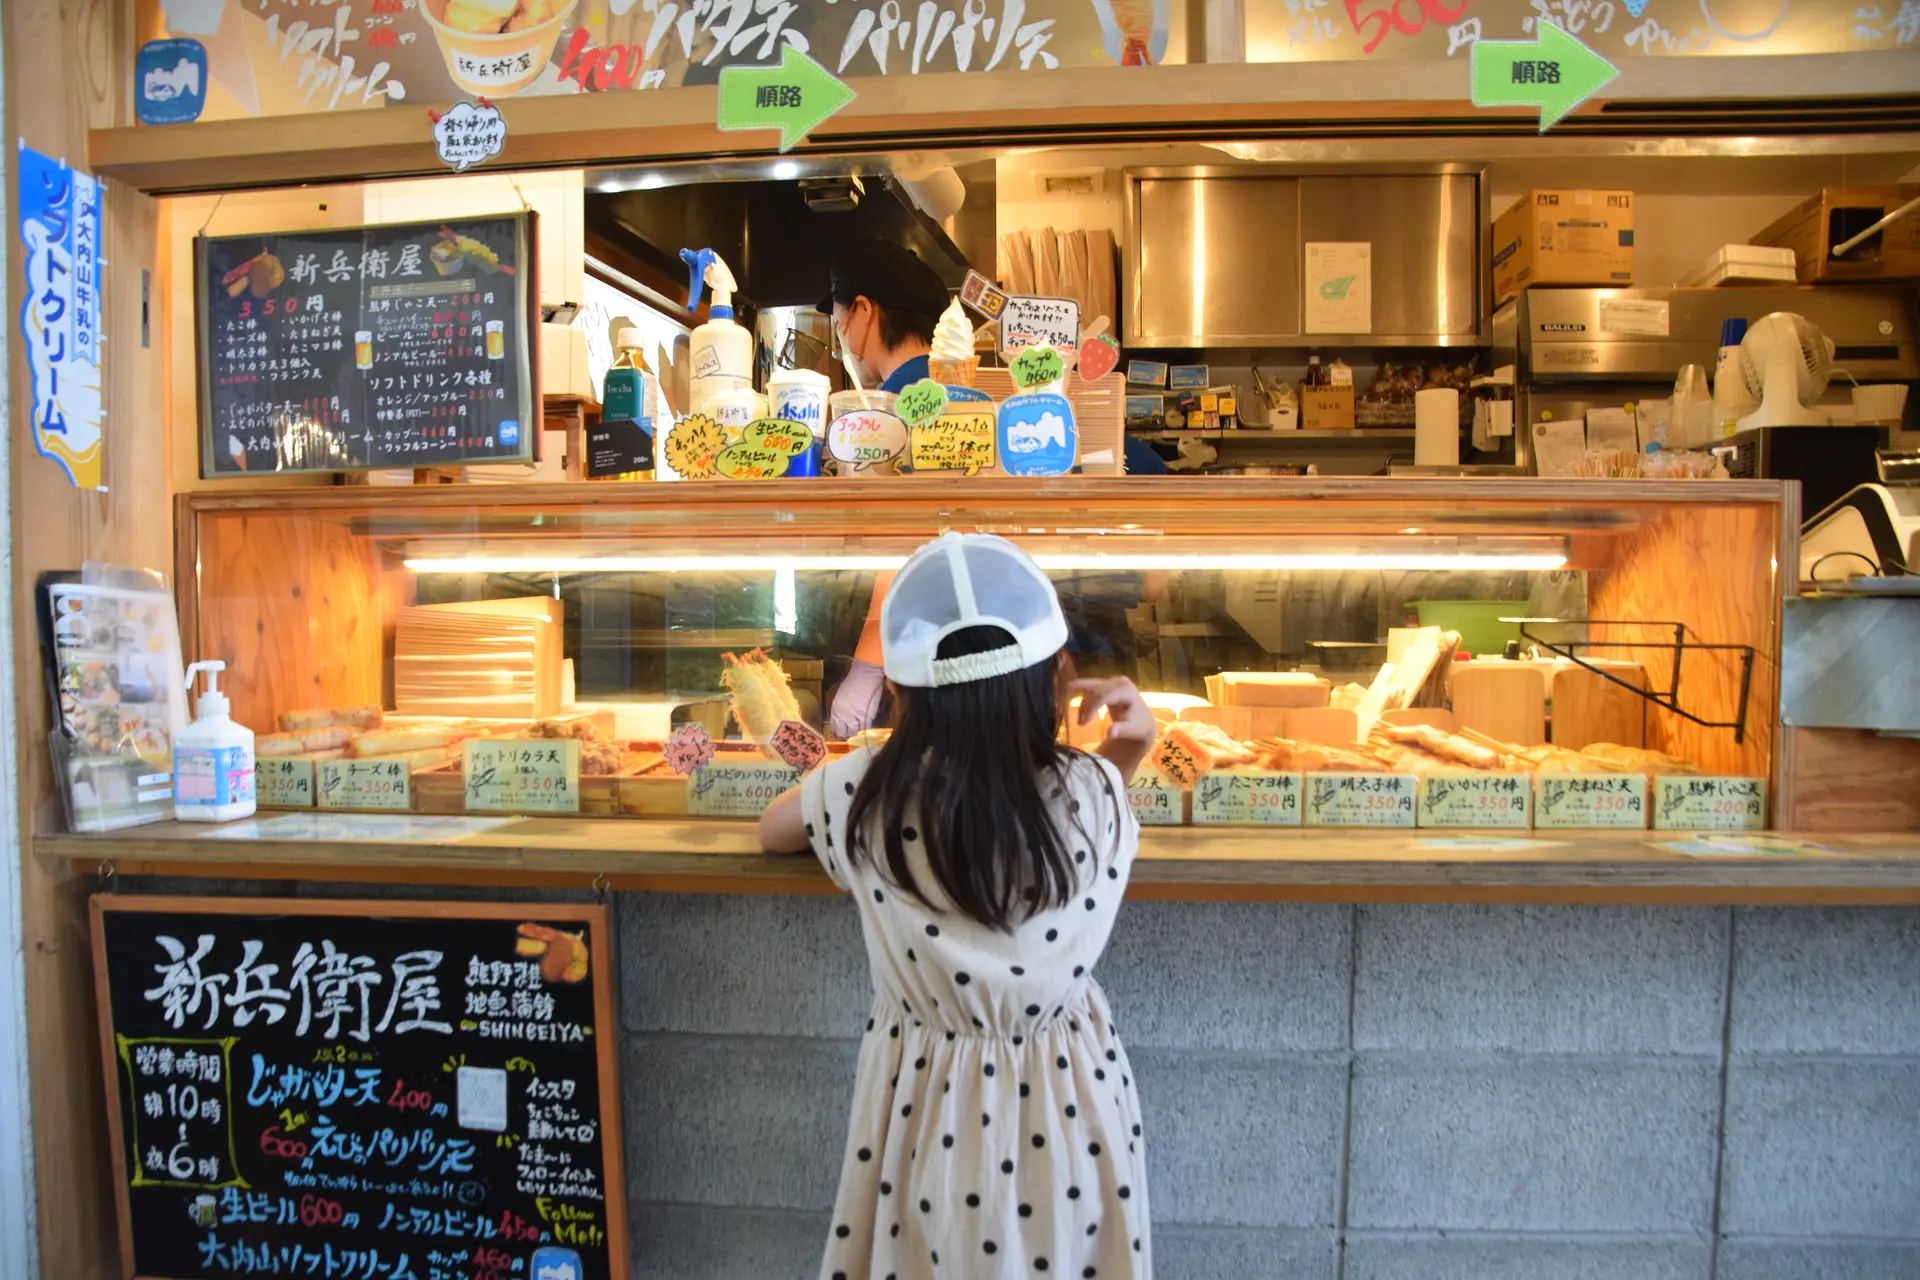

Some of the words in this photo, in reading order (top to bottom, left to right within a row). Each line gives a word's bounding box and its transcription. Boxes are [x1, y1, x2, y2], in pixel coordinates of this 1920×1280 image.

[265, 5, 360, 68] ソフト
[297, 55, 406, 110] クリーム
[1512, 59, 1562, 86] 順路
[755, 83, 803, 109] 順路
[288, 243, 423, 286] 新兵衛屋
[75, 220, 93, 346] 大内山牛乳の
[40, 170, 69, 436] ソフトクリーム
[226, 331, 268, 345] チーズ棒
[289, 325, 343, 340] たまねぎ天
[290, 340, 343, 354] たこマヨ棒
[1017, 352, 1052, 370] カップ
[270, 368, 322, 381] フランク天
[369, 368, 492, 391] ソフトドリンク各種
[902, 388, 931, 411] コーン
[776, 400, 820, 420] Asahi
[755, 421, 792, 436] 生ビール
[725, 450, 777, 463] ノンアルビール
[853, 447, 891, 461] 250円
[498, 749, 561, 764] トリカラ天
[347, 761, 403, 777] チーズ棒
[713, 768, 801, 784] エビのパリパリ天
[269, 777, 308, 793] 350円
[364, 777, 405, 796] 350円
[519, 775, 567, 792] 350円
[1229, 774, 1293, 790] たこマヨ棒
[1339, 776, 1403, 792] 明太子棒
[1447, 776, 1520, 793] いかげそ棒
[1567, 777, 1633, 794] たまねぎ天
[1686, 777, 1762, 798] 熊野じゃこ天
[1248, 792, 1295, 810] 350円
[1363, 795, 1412, 811] 350円
[1476, 796, 1524, 812] 350円
[1595, 796, 1641, 812] 350円
[1713, 799, 1759, 815] 200円
[143, 933, 454, 1042] 新兵衛屋
[478, 1019, 585, 1042] SHINBEIYA
[136, 1046, 222, 1083] 営業時間
[247, 1053, 382, 1109] じゃがバター天
[525, 1076, 576, 1101] インスタ
[143, 1083, 222, 1125] 朝10時
[387, 1078, 448, 1120] 400円
[309, 1113, 476, 1176] えびのパリパリ天
[145, 1141, 220, 1182] 夜6時
[219, 1186, 298, 1225] 生ビール
[300, 1193, 360, 1229] 600円
[535, 1197, 594, 1221] Follow
[377, 1202, 497, 1239] ノンアルビール
[498, 1209, 550, 1243] 450円
[198, 1231, 418, 1280] 大内山ソフトクリーム
[426, 1250, 469, 1268] カップ
